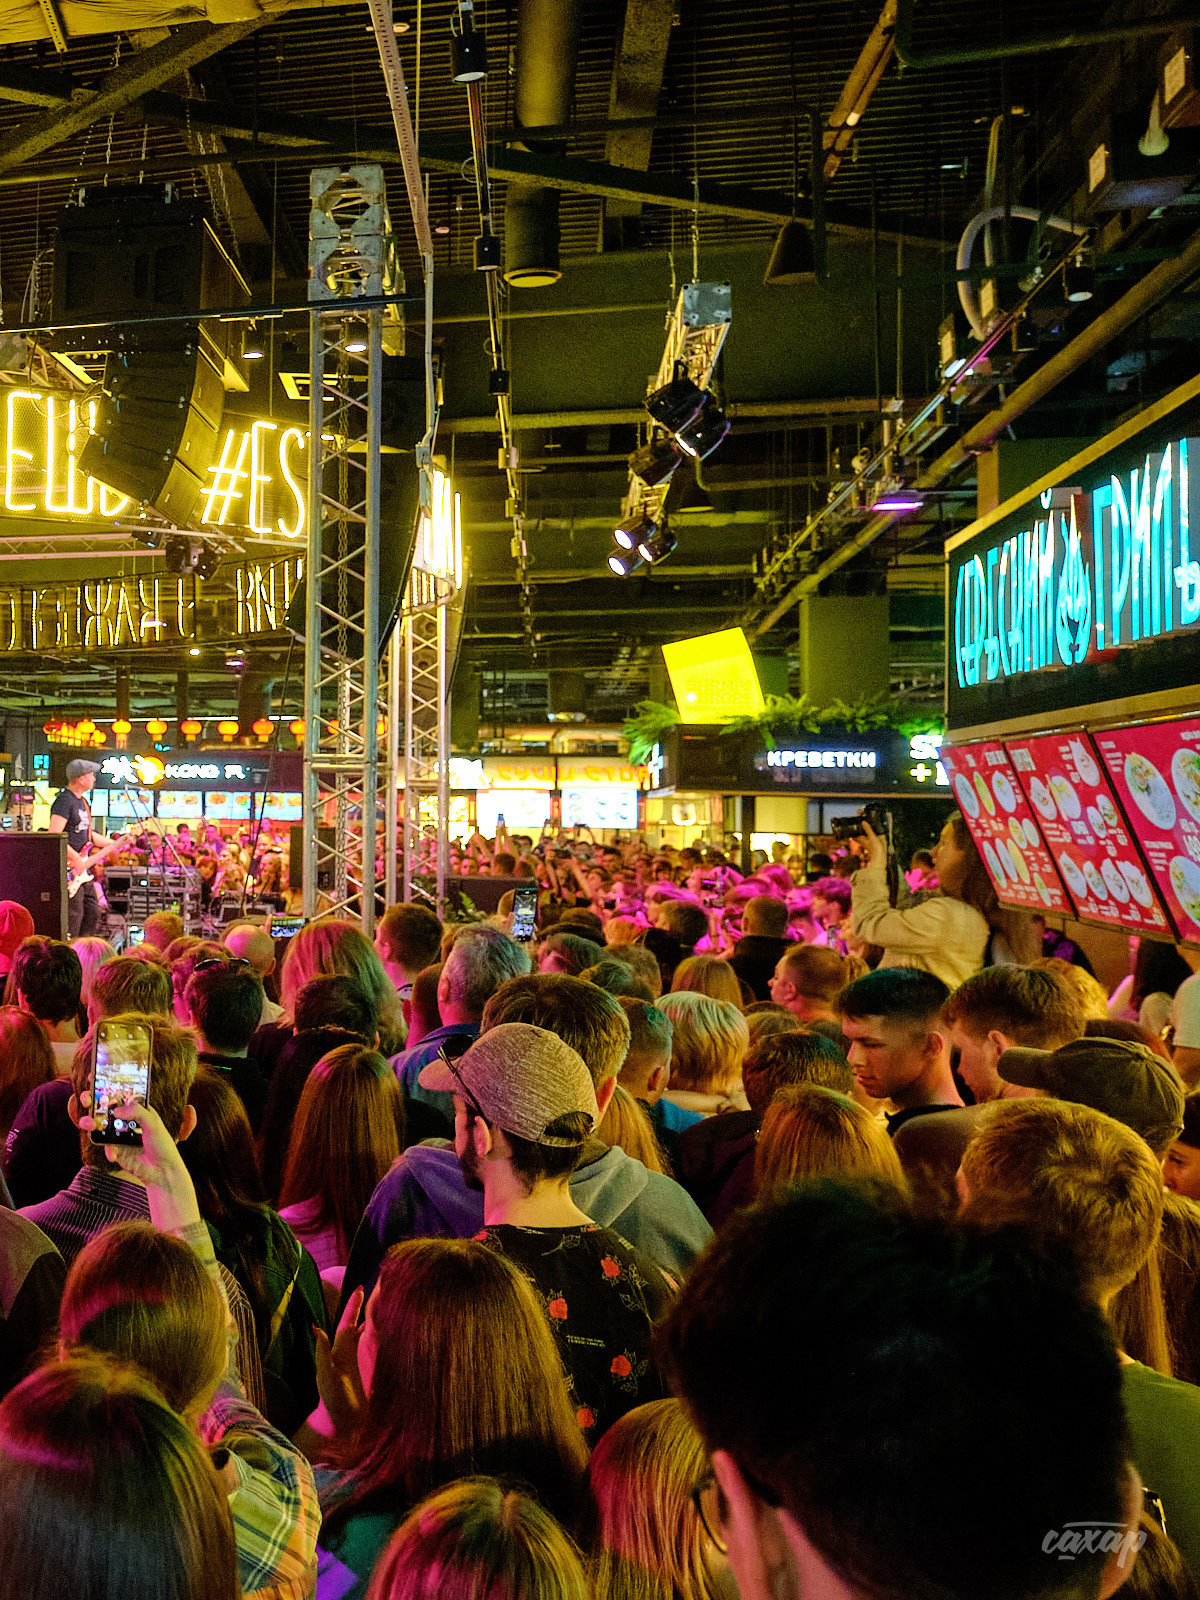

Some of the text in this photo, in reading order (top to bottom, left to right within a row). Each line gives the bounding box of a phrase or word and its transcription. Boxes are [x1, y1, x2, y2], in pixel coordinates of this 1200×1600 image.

[200, 420, 312, 538] #ES
[1092, 436, 1200, 651] ГРИЛЬ
[497, 764, 575, 782] СУШИ
[766, 750, 877, 768] КРЕВЕТКИ
